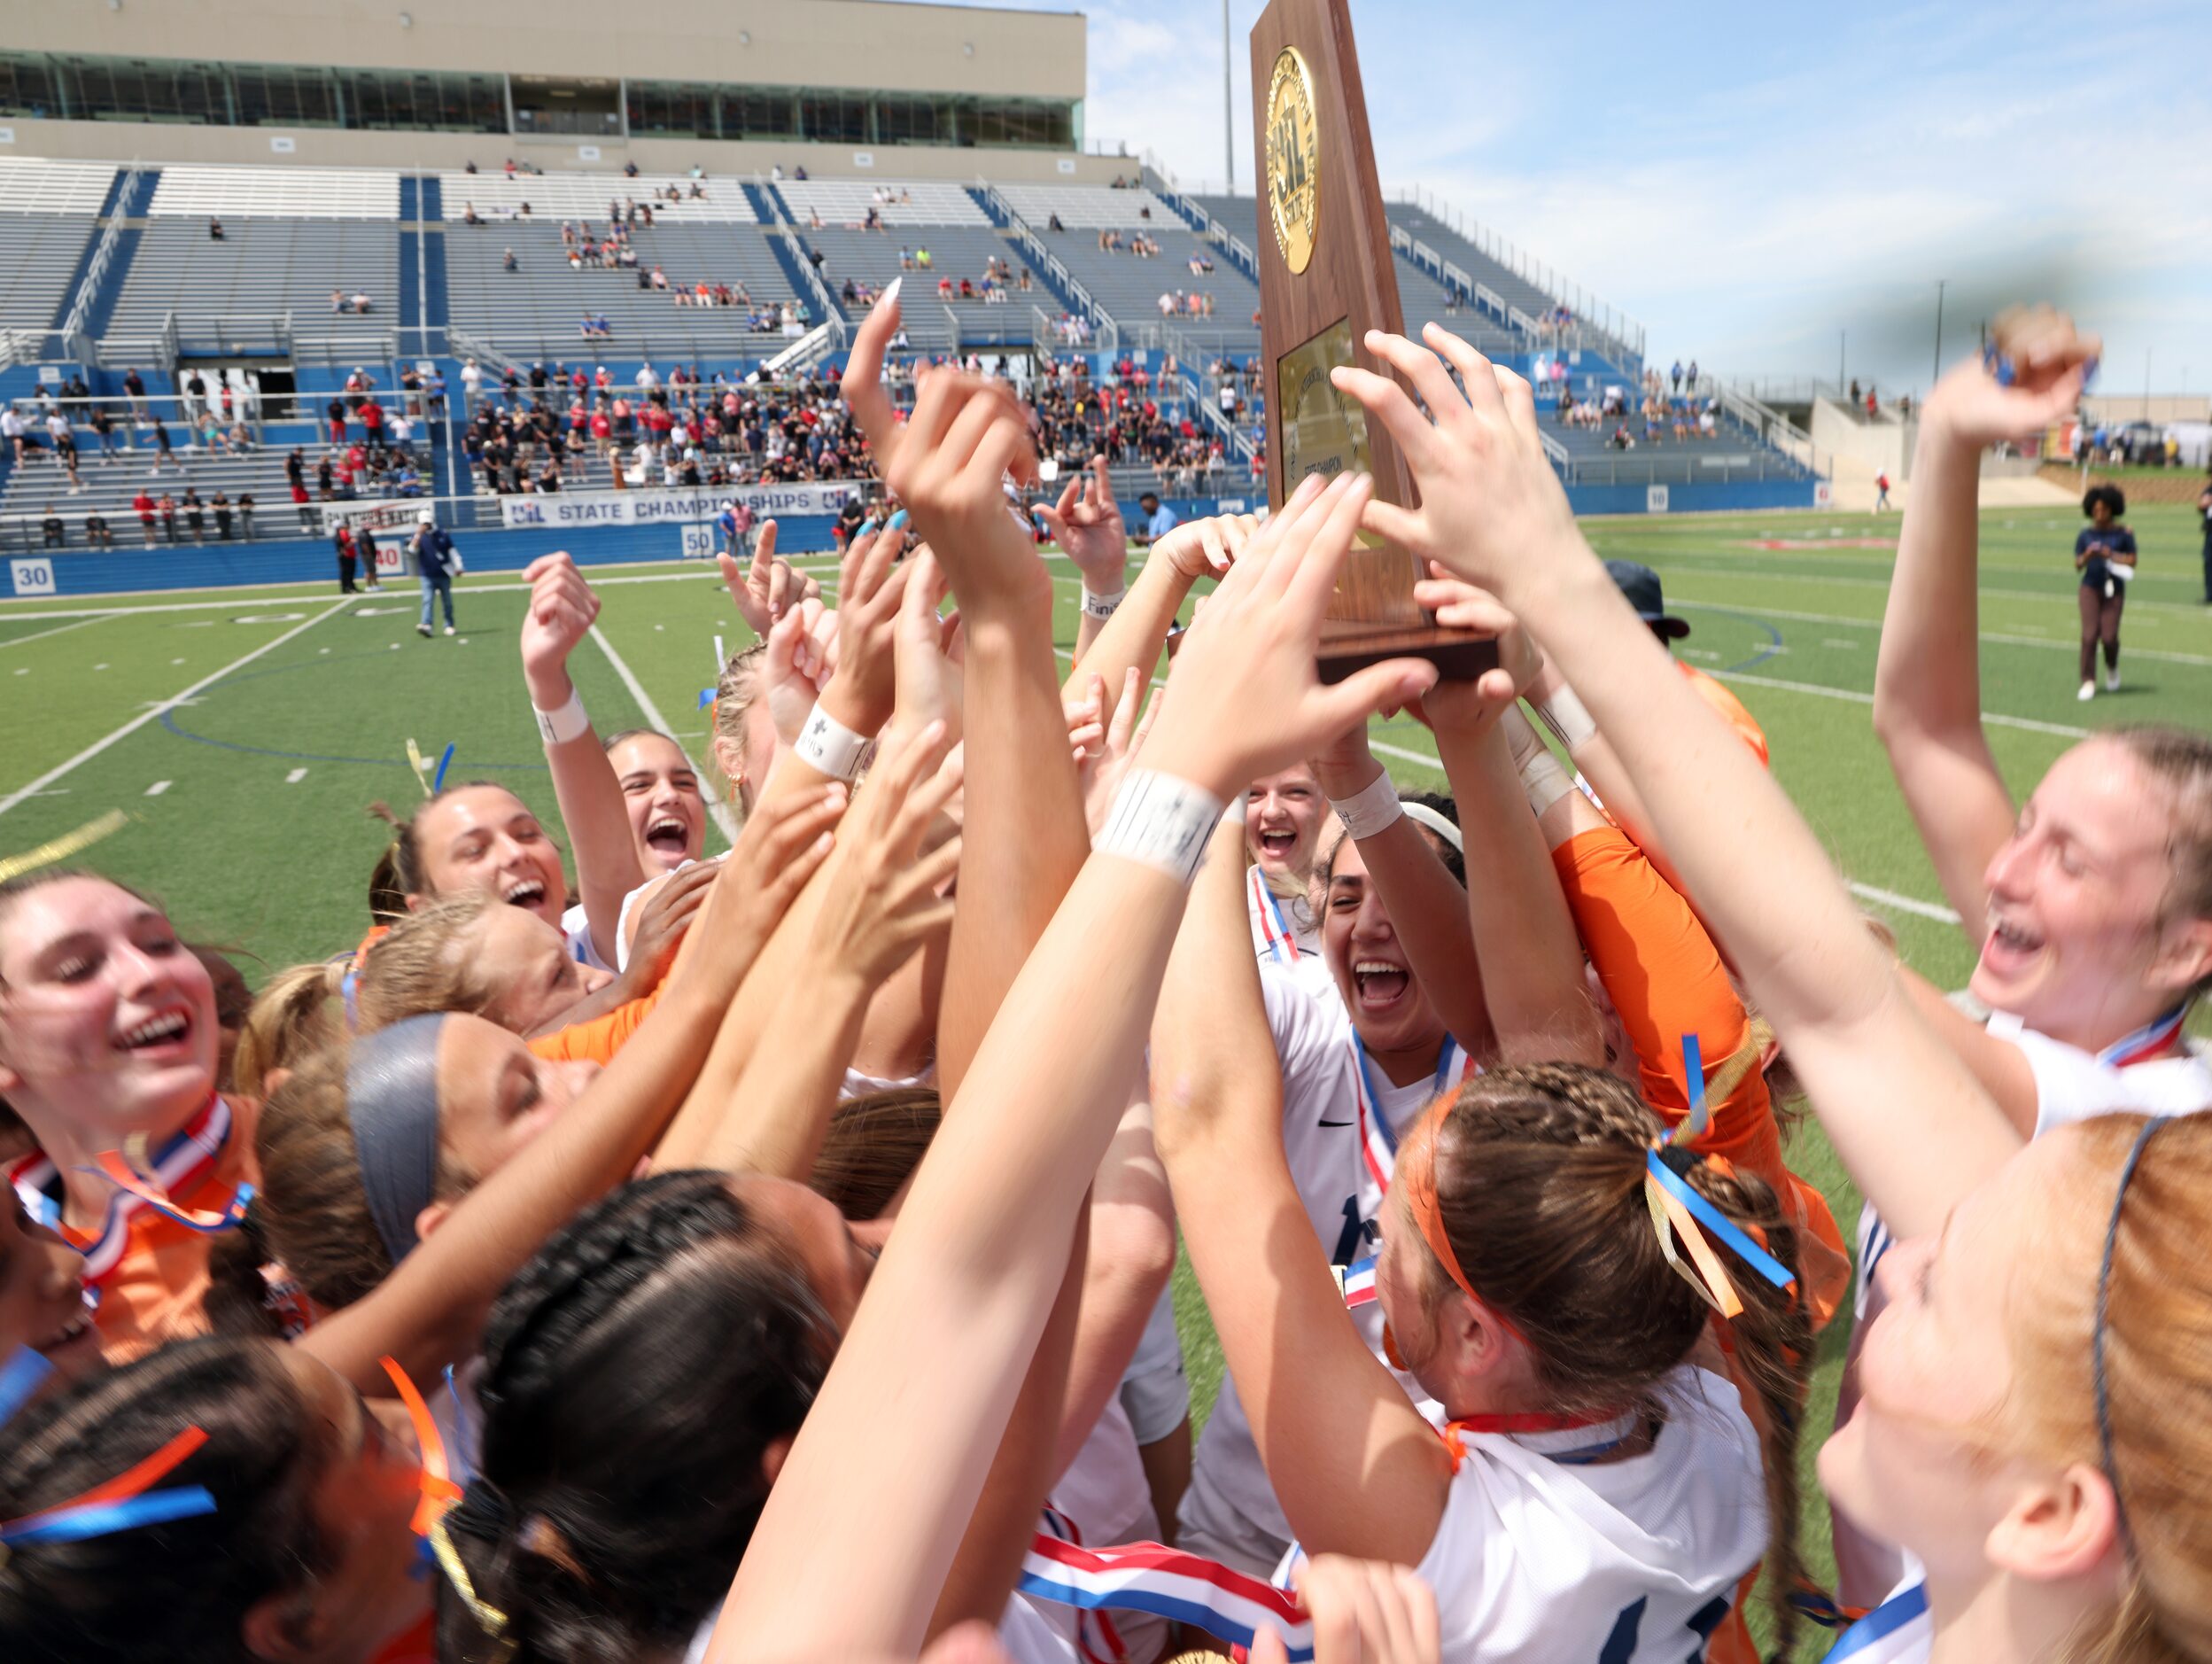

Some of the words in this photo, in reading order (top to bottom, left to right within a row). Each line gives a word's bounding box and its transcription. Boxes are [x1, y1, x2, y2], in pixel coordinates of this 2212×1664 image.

[558, 503, 623, 521] STATE
[687, 533, 710, 549] 50
[19, 566, 48, 586] 30
[1088, 596, 1122, 615] Finis
